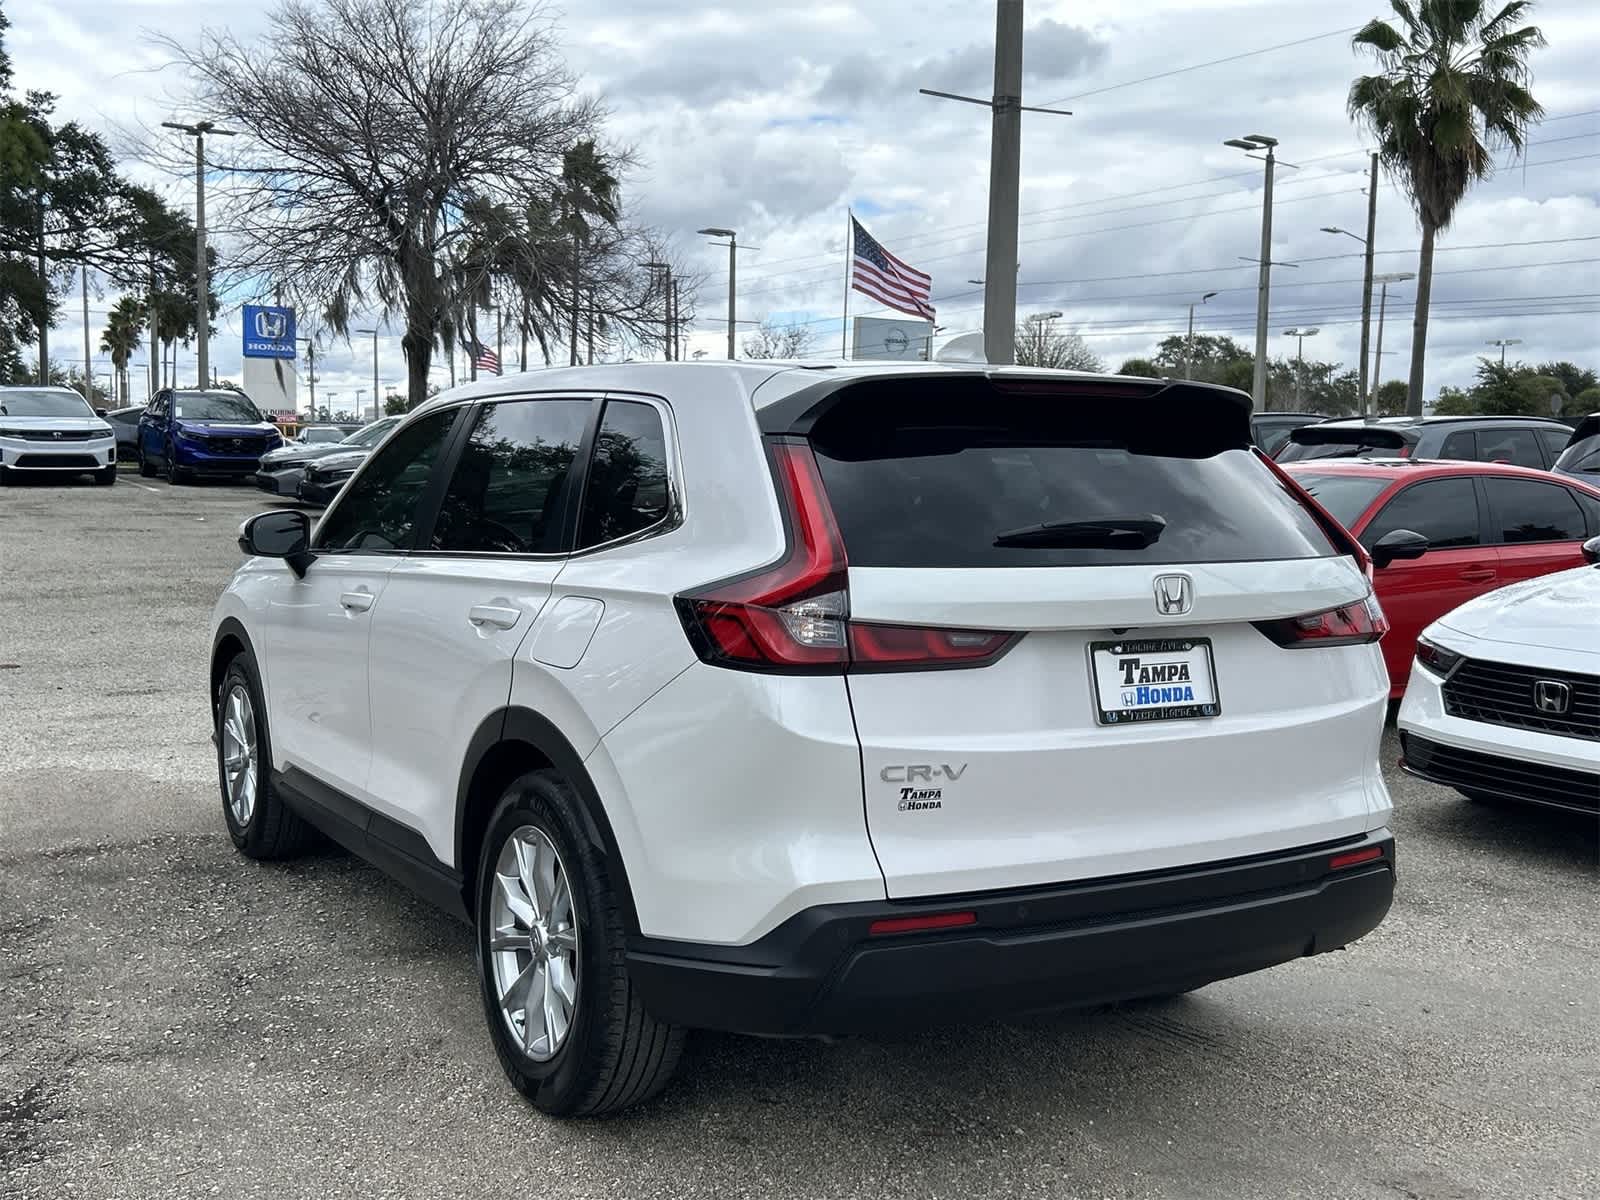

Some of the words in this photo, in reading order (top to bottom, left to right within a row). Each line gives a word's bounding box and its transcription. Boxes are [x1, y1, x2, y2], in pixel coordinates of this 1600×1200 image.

[247, 343, 294, 352] HONDA
[1118, 658, 1190, 685] TAMPA
[1136, 686, 1194, 705] HONDA
[880, 763, 967, 782] CR-V
[900, 787, 942, 800] TAMPA
[907, 801, 942, 810] HONDA
